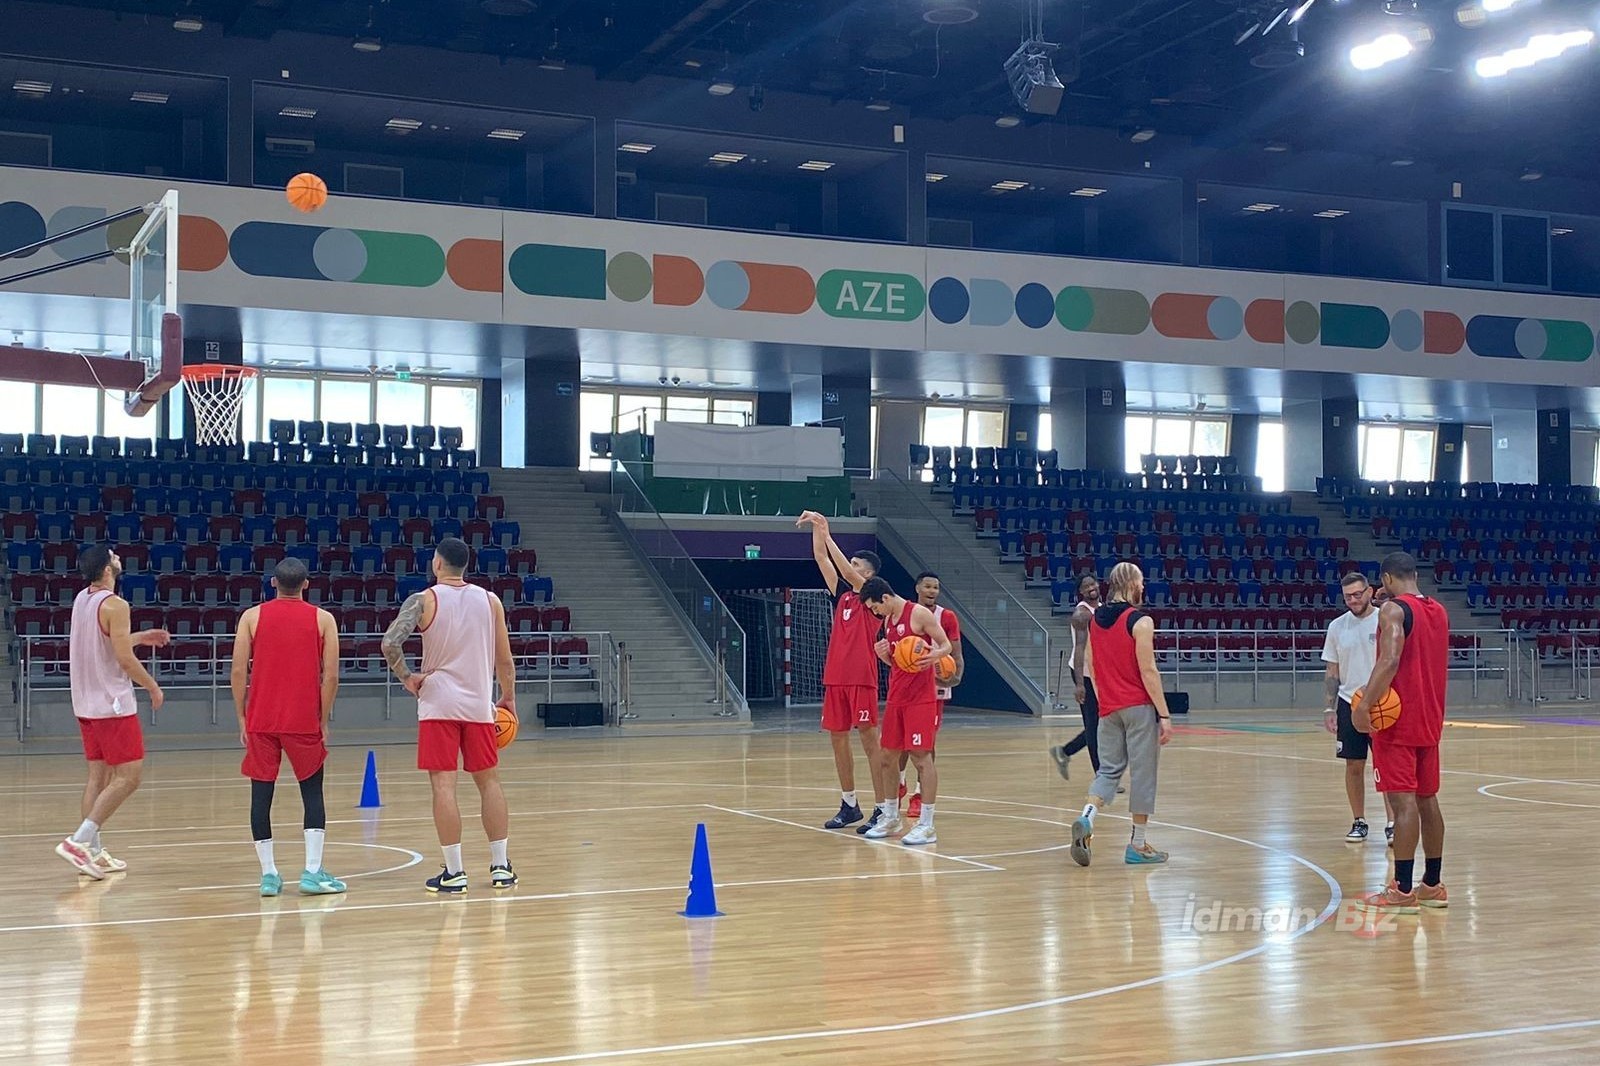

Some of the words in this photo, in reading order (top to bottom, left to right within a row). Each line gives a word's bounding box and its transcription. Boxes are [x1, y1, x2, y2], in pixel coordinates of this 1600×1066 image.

[836, 280, 905, 314] AZE
[206, 343, 218, 352] 12
[859, 710, 869, 721] 22
[912, 733, 921, 745] 21
